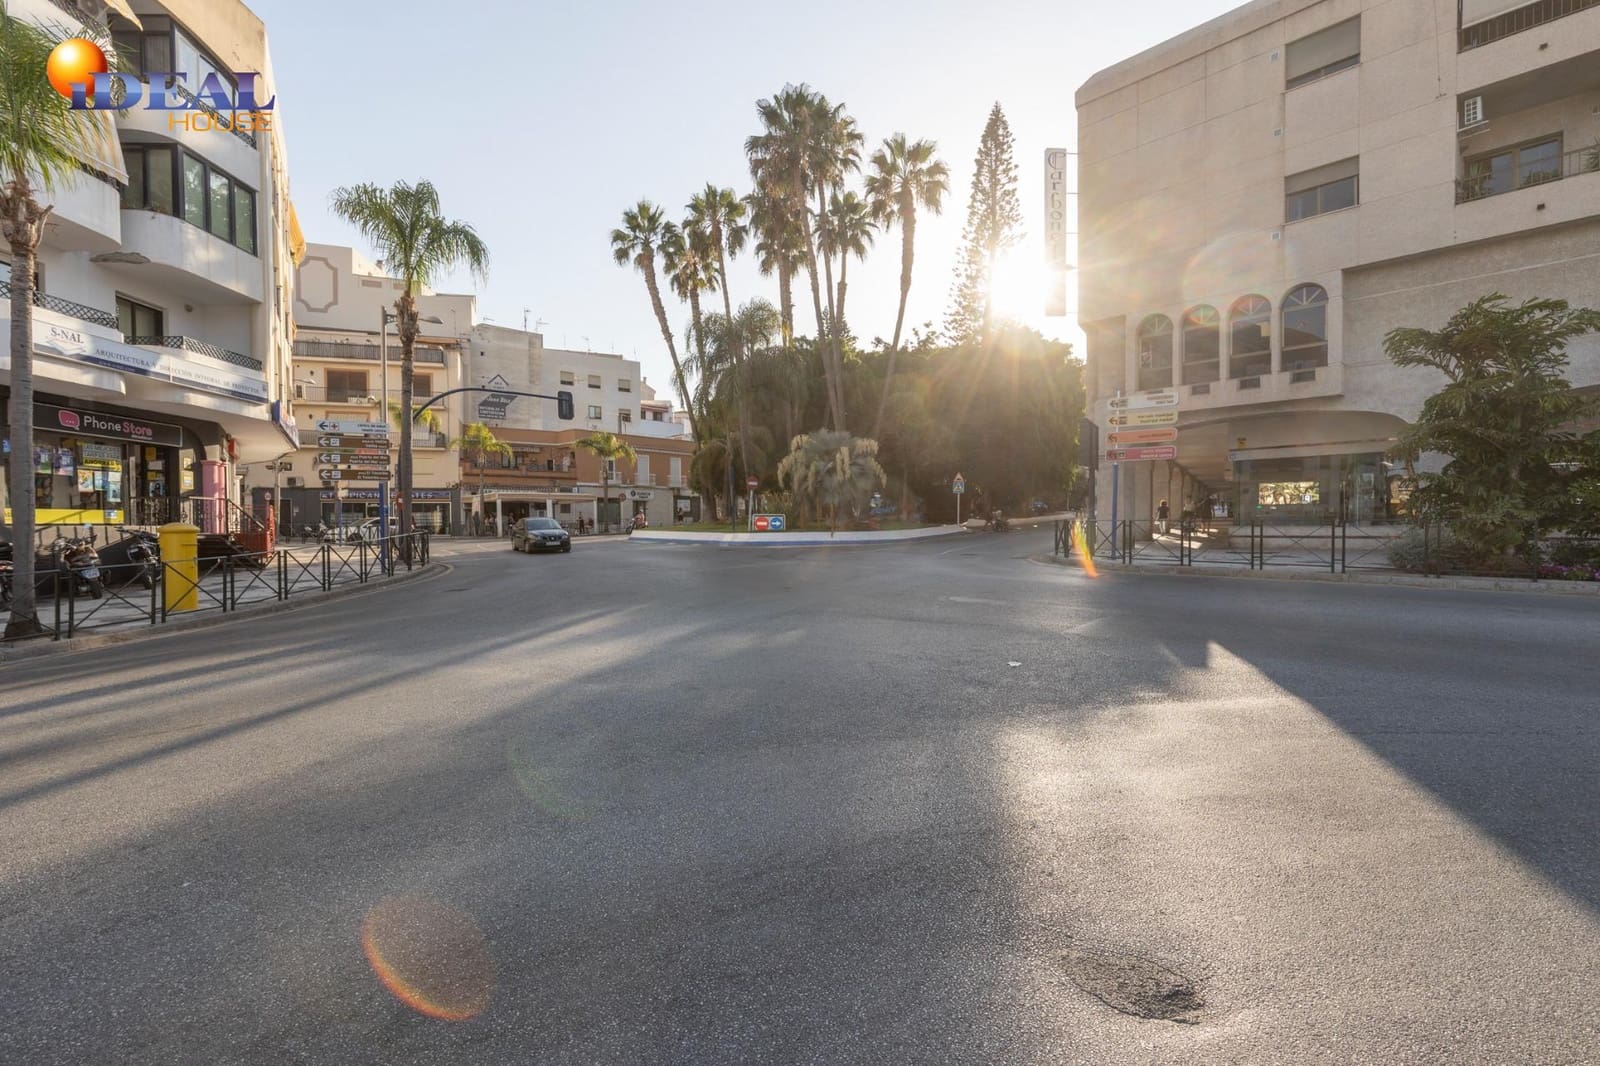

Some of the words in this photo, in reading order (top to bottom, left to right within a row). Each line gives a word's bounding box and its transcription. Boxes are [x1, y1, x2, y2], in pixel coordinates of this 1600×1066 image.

[50, 327, 84, 344] S-NAL
[95, 348, 149, 366] ARQUITECTURA
[84, 415, 121, 431] Phone
[122, 421, 153, 437] Store
